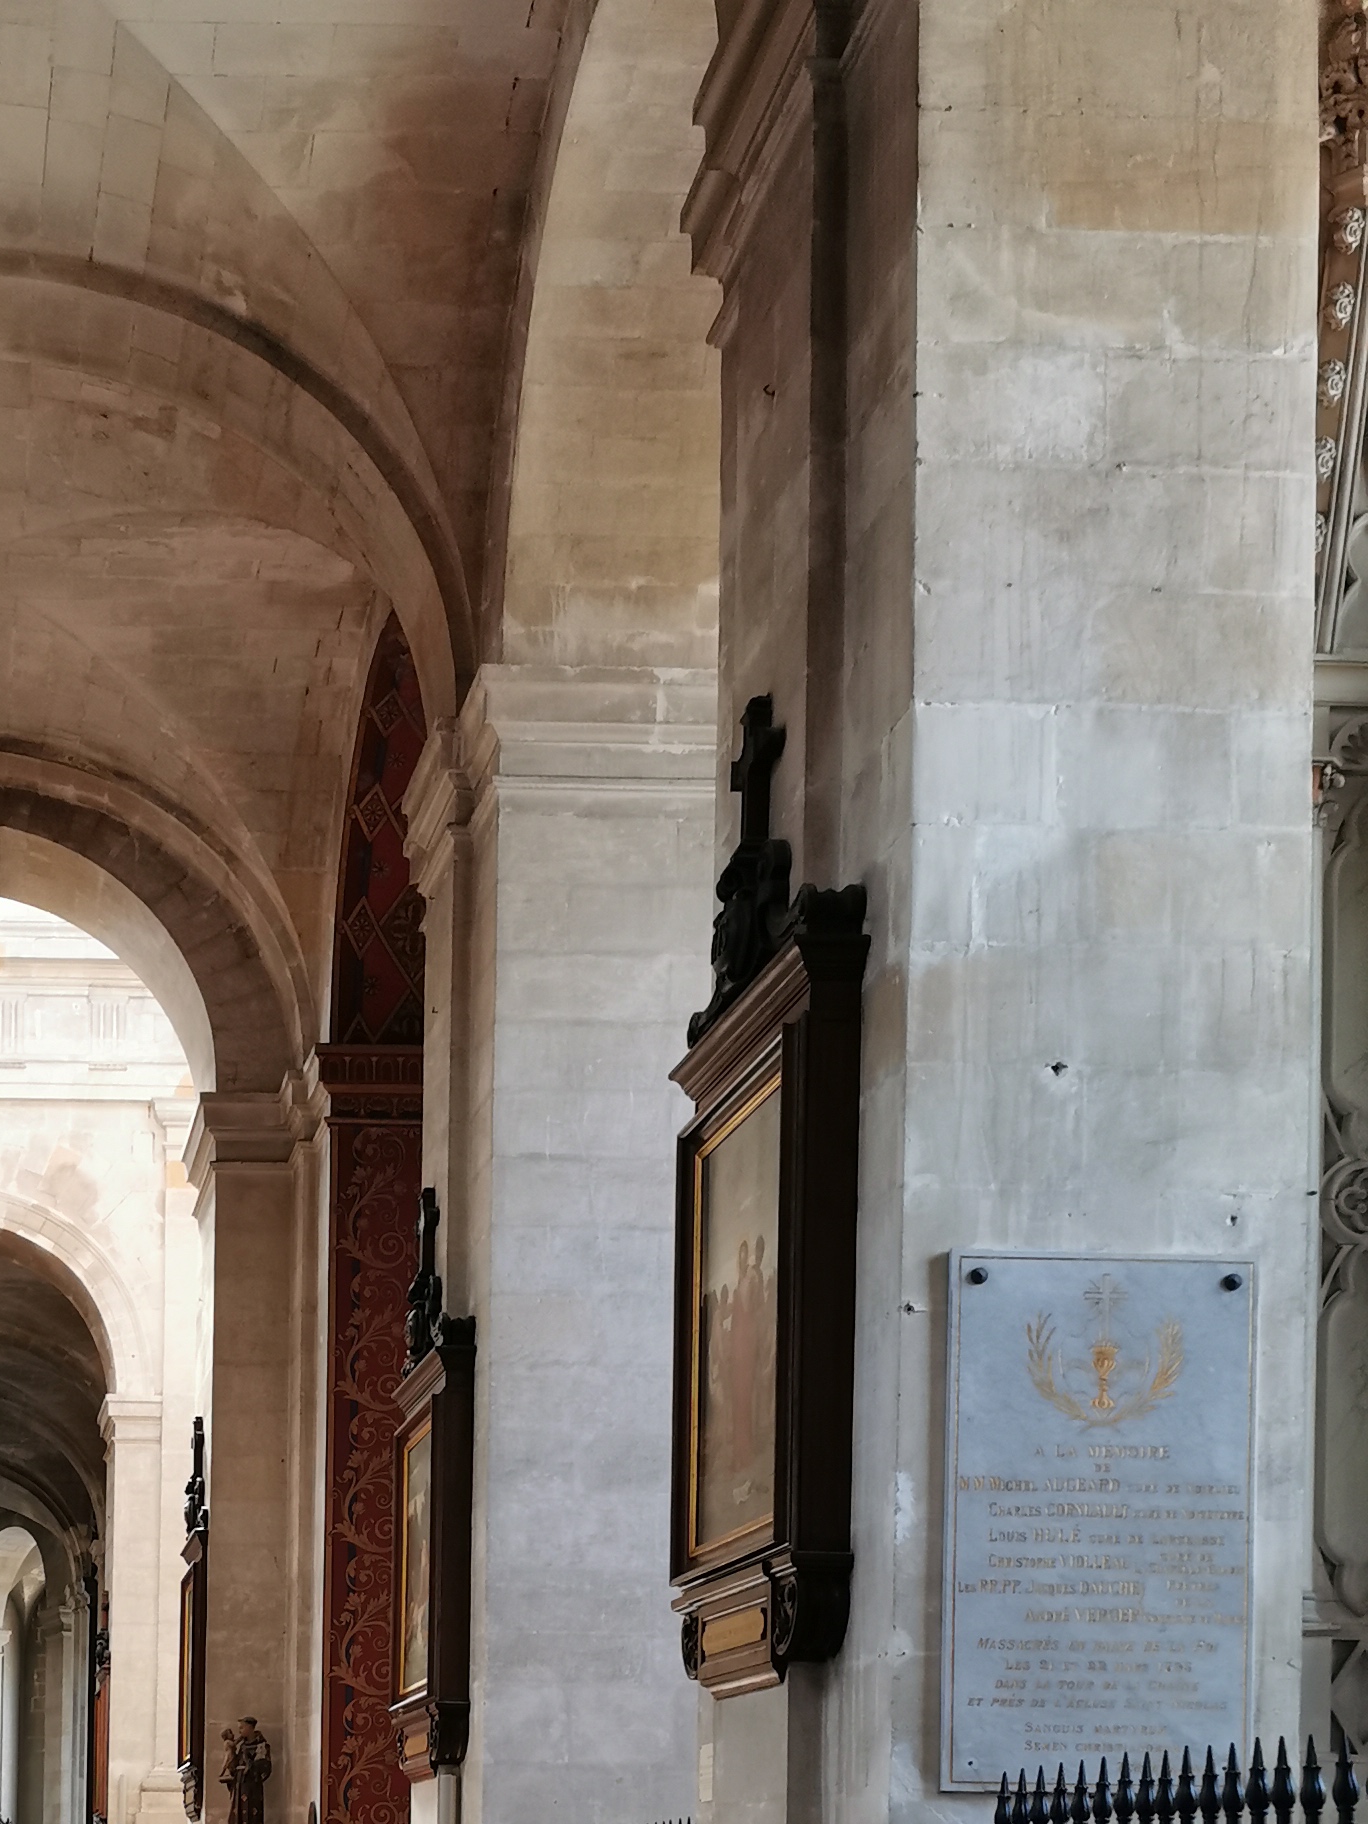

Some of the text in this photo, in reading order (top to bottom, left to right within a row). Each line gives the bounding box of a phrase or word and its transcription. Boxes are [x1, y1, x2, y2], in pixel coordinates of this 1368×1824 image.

[1055, 1444, 1078, 1458] LA
[1088, 1440, 1170, 1460] MÉMOIRE
[1093, 1463, 1111, 1473] DE
[1045, 1478, 1120, 1493] AUGEARD
[988, 1528, 1028, 1543] LOUIS
[977, 1637, 1059, 1652] MASSACRÉS
[1005, 1659, 1031, 1671] LES
[994, 1679, 1027, 1690] DANS
[1058, 1680, 1094, 1690] TOUR
[967, 1697, 984, 1708] ET
[1030, 1698, 1047, 1708] DE
[1024, 1721, 1084, 1735] SANGUIS
